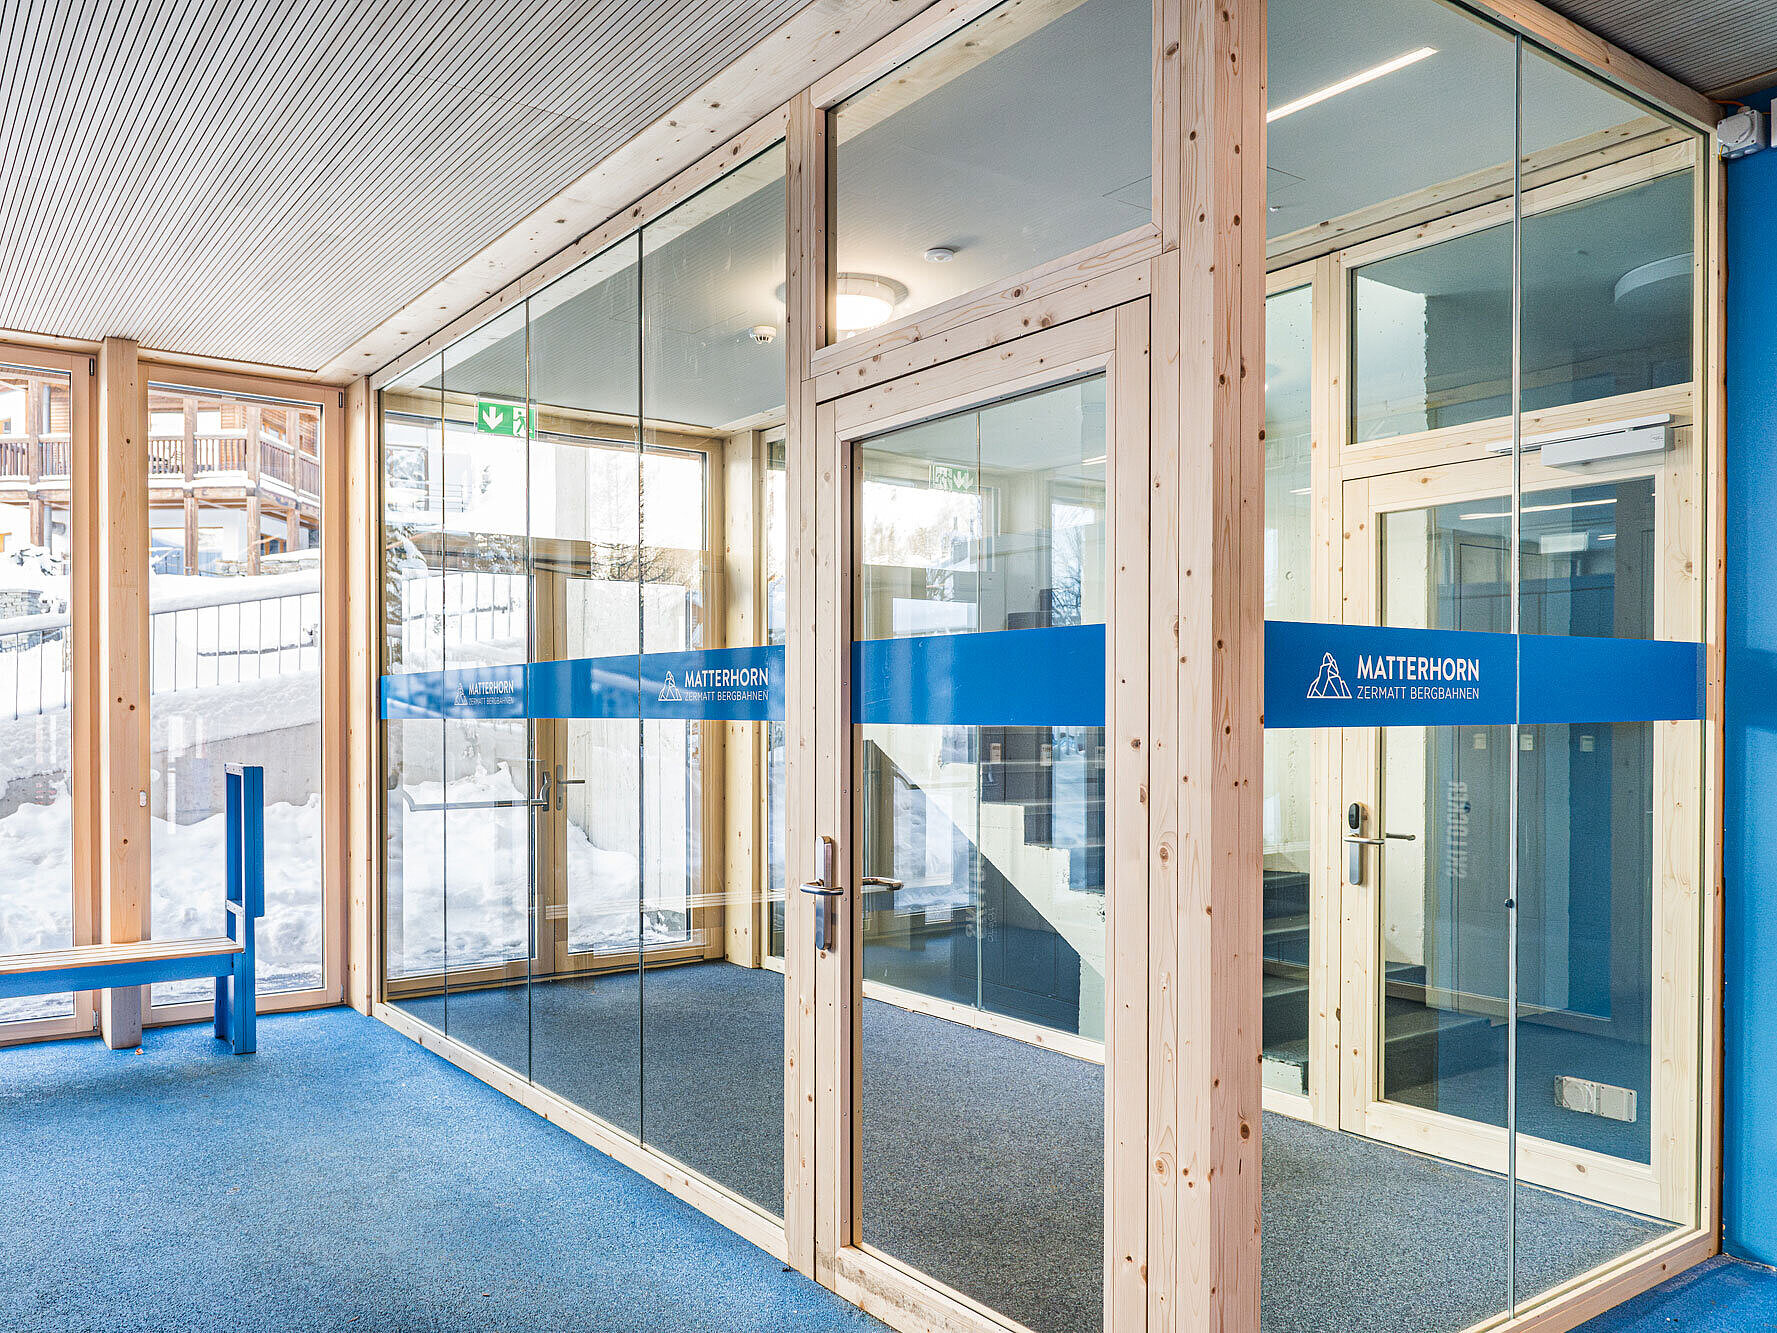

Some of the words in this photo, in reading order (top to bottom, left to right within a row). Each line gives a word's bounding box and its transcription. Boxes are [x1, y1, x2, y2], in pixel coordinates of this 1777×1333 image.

[1357, 655, 1479, 681] MATTERHORN
[685, 668, 768, 687] MATTERHORN
[469, 680, 514, 696] MATTERHORN
[685, 691, 715, 701] ZERMATT
[717, 690, 768, 700] BERGBAHNEN
[1357, 686, 1406, 699] ZERMATT
[1411, 687, 1479, 700] BERGBAHNEN
